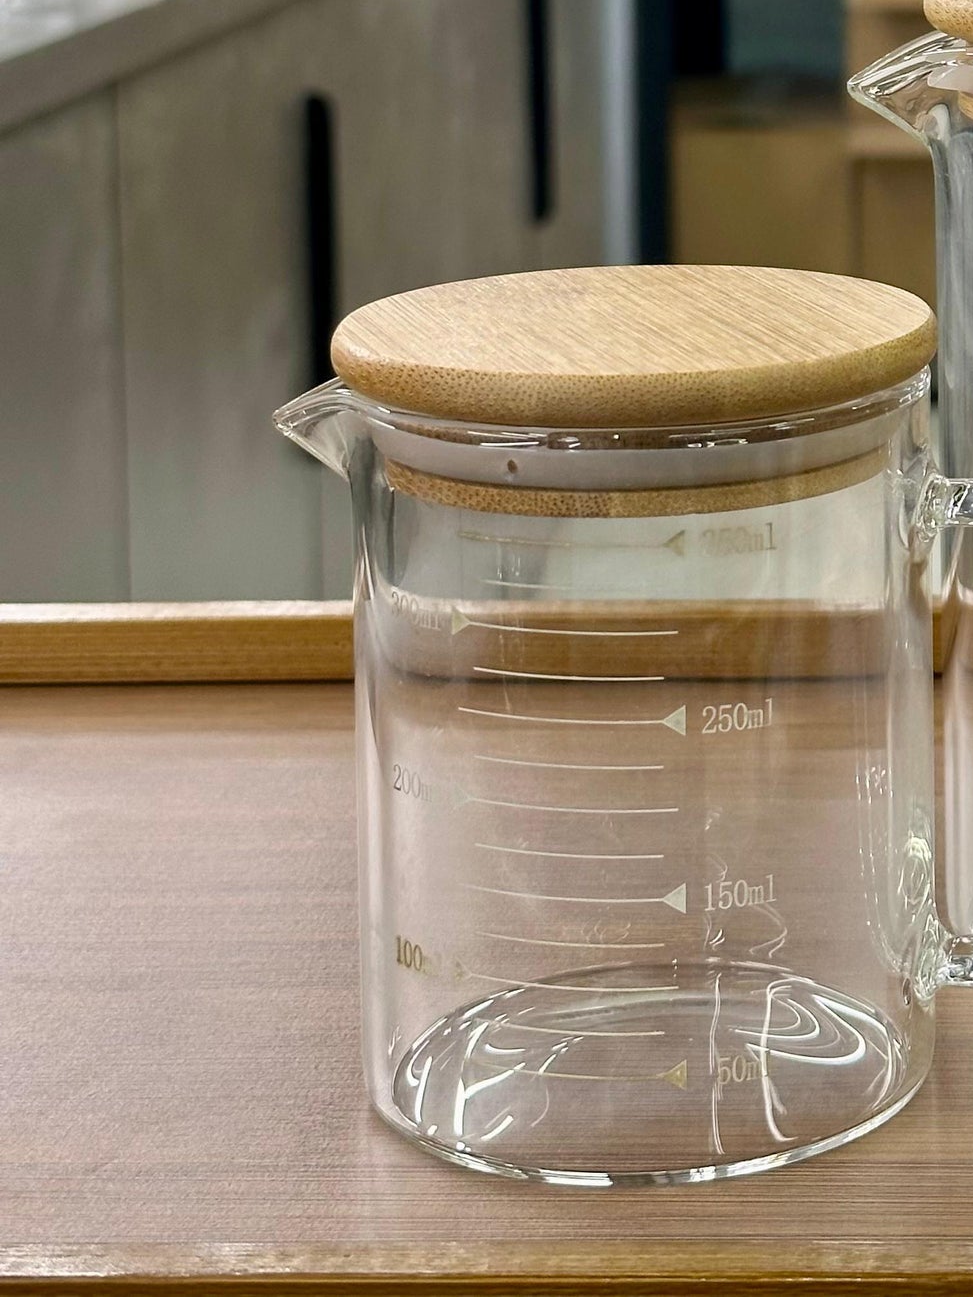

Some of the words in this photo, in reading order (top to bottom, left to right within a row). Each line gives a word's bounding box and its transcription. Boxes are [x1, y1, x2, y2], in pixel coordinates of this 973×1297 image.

[702, 698, 773, 734] 250ml
[393, 764, 436, 803] 200m
[704, 874, 777, 911] 150ml
[717, 1055, 767, 1085] 50m
